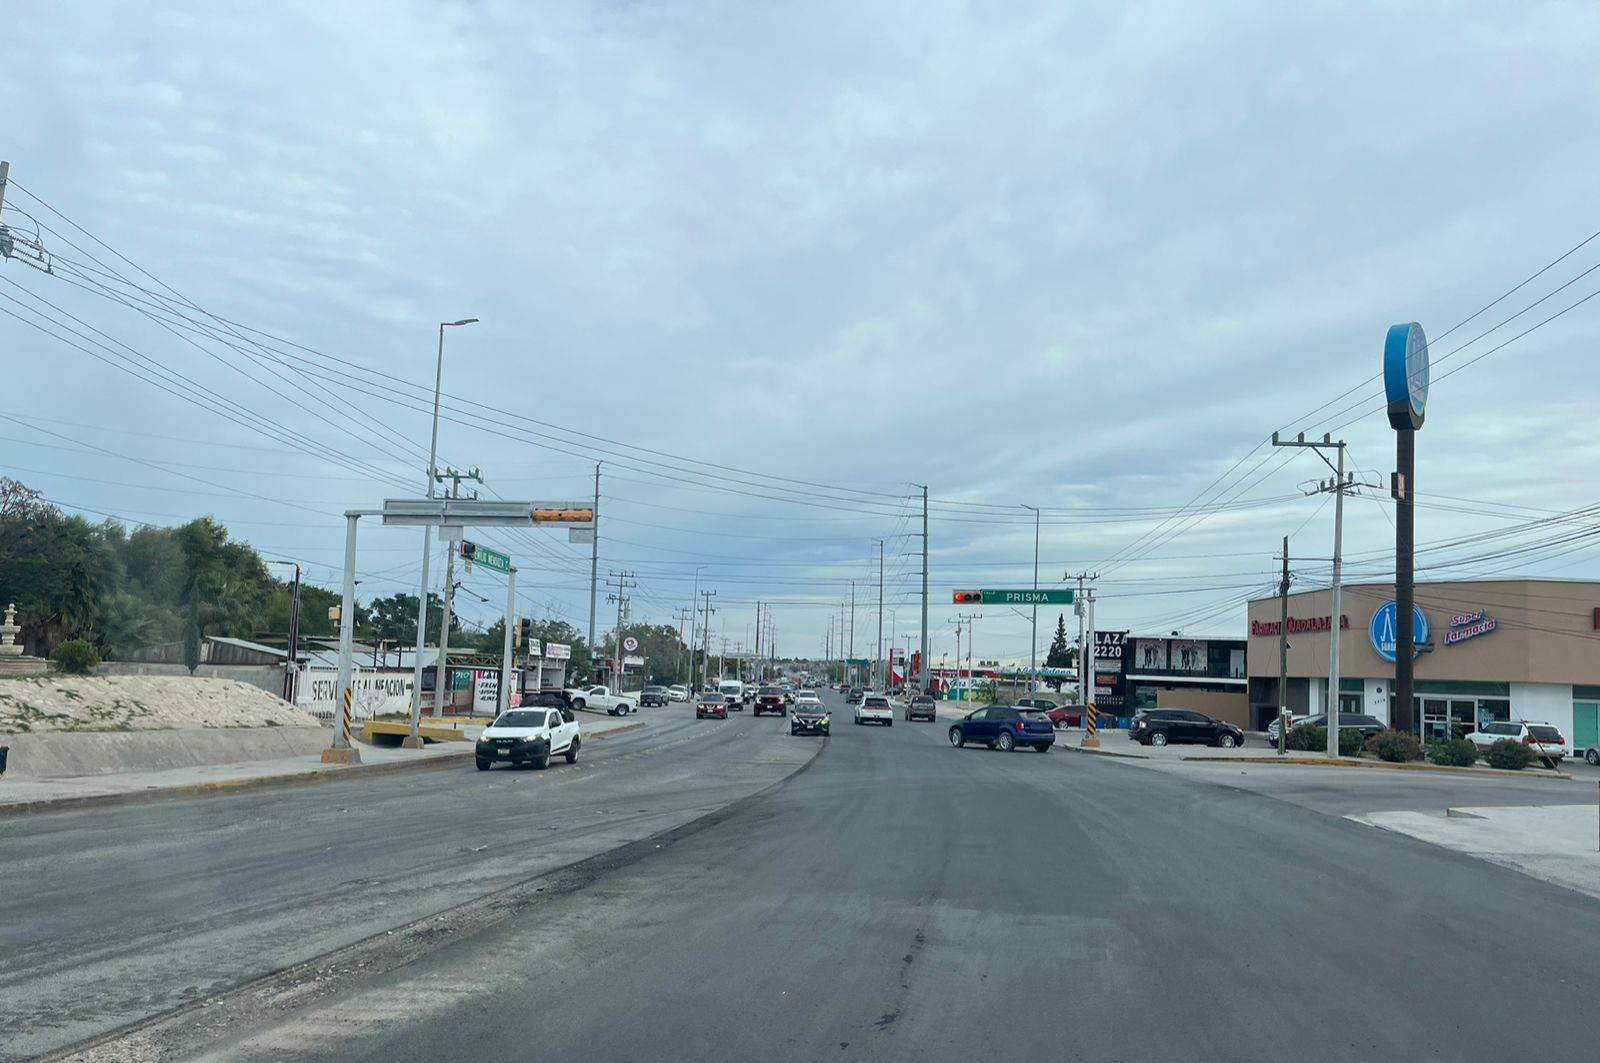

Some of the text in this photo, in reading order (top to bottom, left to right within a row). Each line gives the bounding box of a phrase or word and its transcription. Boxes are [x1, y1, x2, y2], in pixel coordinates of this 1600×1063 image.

[1006, 592, 1050, 603] PRISMA
[1251, 615, 1351, 637] FARMACI GUADALAJAA
[1450, 608, 1485, 627] Super
[1092, 633, 1128, 646] LAZA
[1444, 618, 1497, 645] Farmacia
[1093, 645, 1122, 658] 2220
[362, 678, 406, 697] ALNEACION
